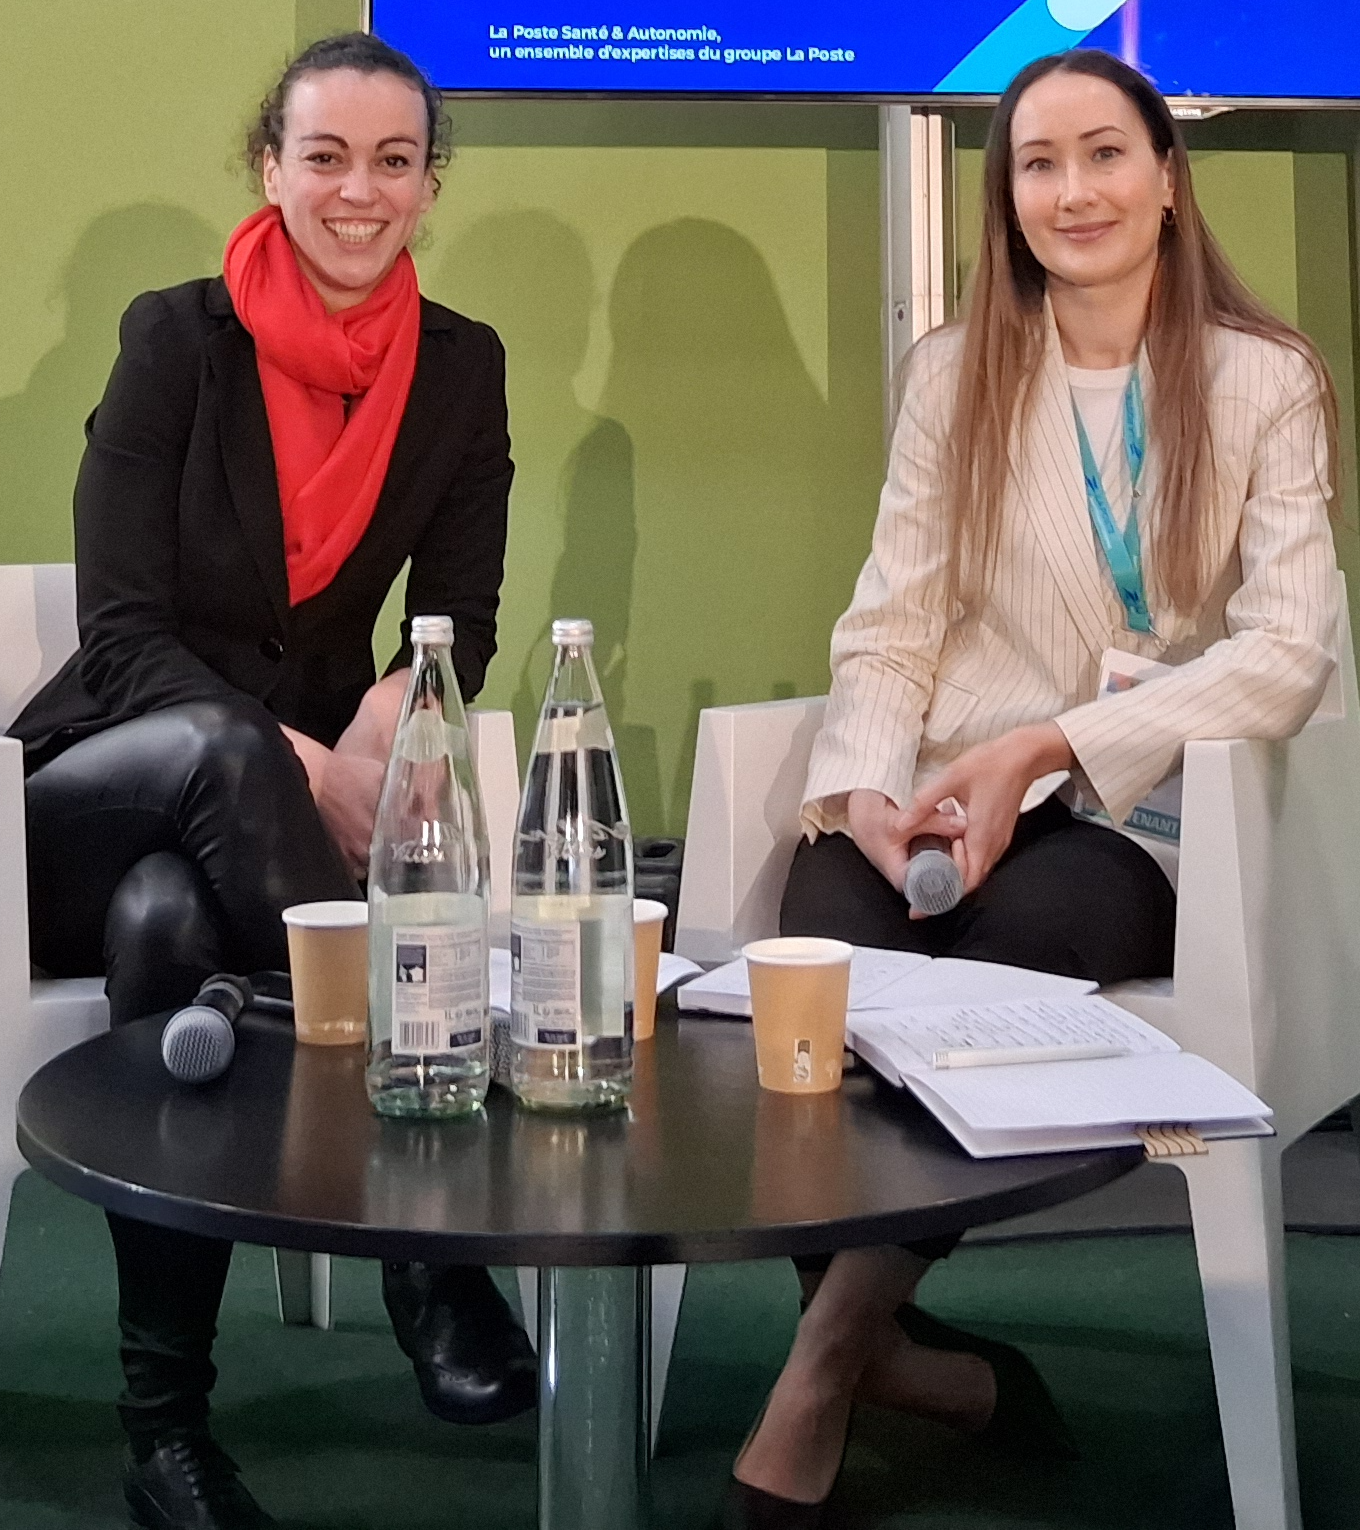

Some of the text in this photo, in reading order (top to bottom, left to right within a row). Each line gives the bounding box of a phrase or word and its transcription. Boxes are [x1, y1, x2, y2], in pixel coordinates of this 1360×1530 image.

[489, 24, 722, 44] La Poste Santé & Autonomie,
[489, 45, 512, 59] un
[514, 43, 594, 60] ensemble
[699, 45, 721, 61] du
[724, 47, 783, 65] groupe
[786, 46, 805, 62] La
[808, 47, 856, 62] Poste
